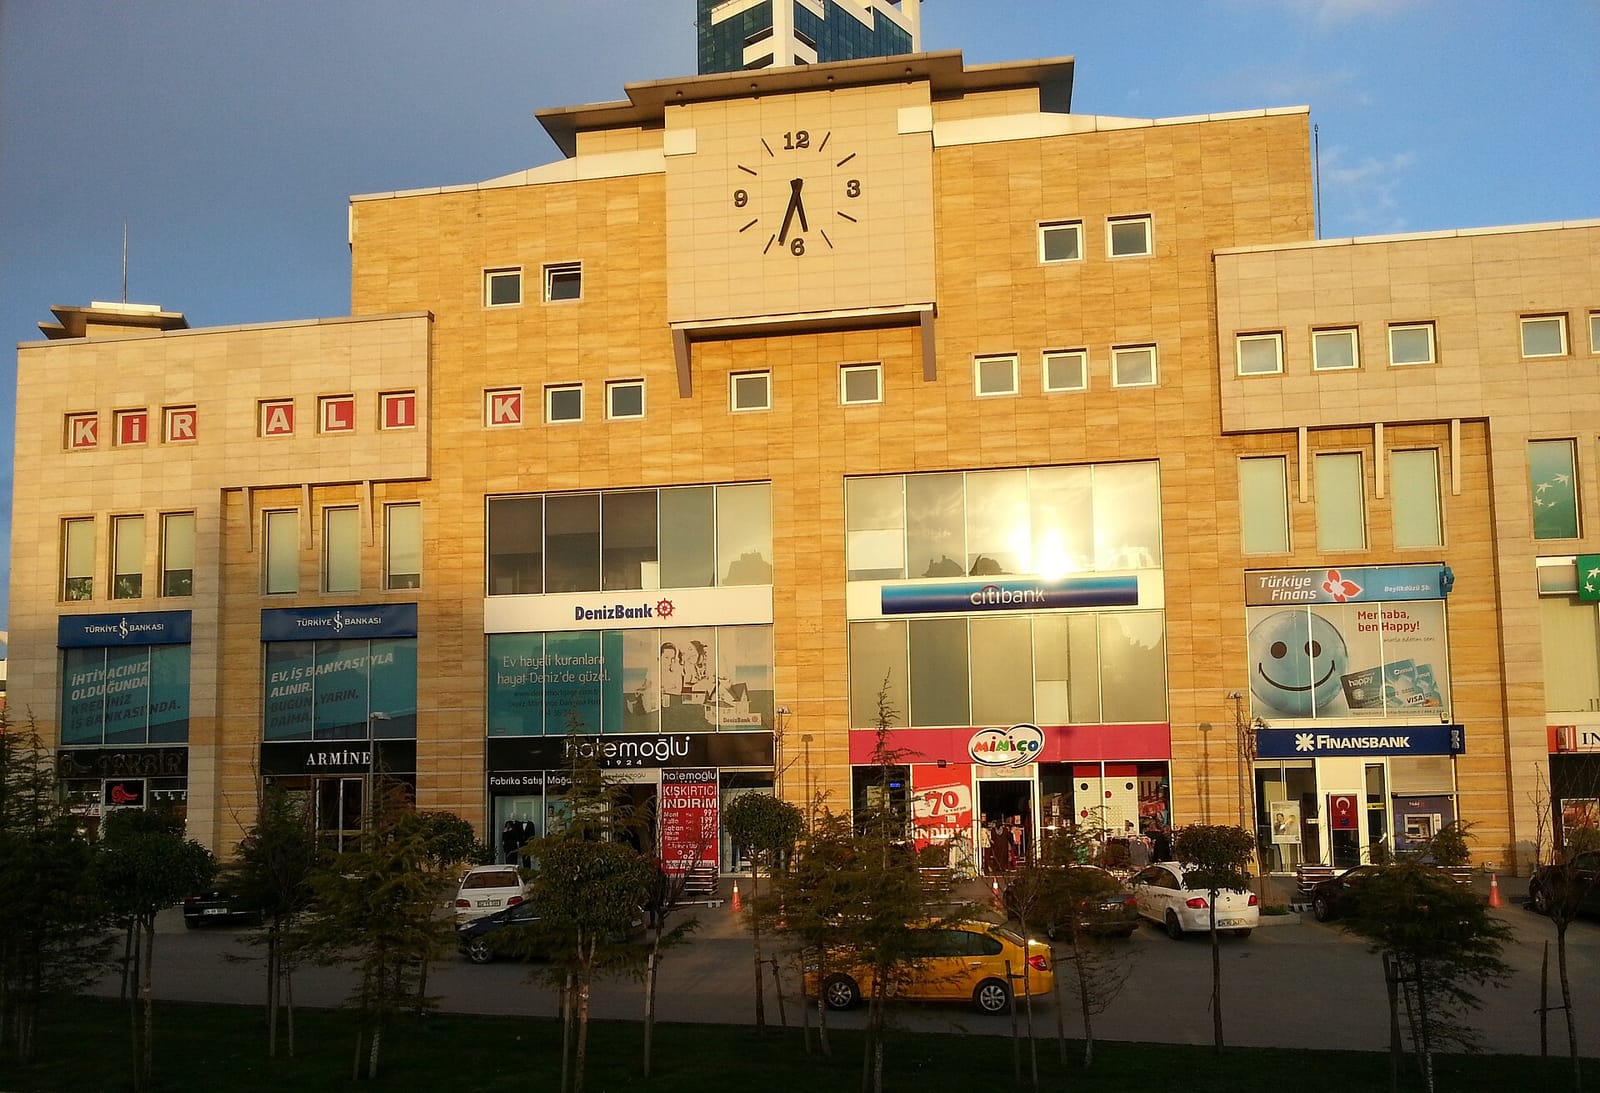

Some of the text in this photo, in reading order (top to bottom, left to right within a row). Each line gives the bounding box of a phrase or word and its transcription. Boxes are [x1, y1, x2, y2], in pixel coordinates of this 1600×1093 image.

[783, 130, 810, 150] 12
[846, 179, 861, 198] 3
[733, 189, 749, 208] 9
[790, 238, 805, 256] 6
[1260, 575, 1312, 590] Türkiye
[969, 586, 1047, 607] citibank
[1271, 587, 1317, 602] Finans
[574, 604, 653, 621] DenizBank
[84, 624, 118, 634] TÜRKİYE
[129, 623, 164, 633] BANKASI
[296, 618, 332, 627] TÜRKİYE
[344, 617, 382, 625] BANKASI
[1357, 620, 1420, 632] ben Happy!
[503, 653, 605, 670] Ev hayali kuranlara
[71, 661, 149, 687] İHTİYACINIZ
[497, 672, 527, 688] hayat
[270, 682, 313, 698] ALINIR.
[1406, 695, 1424, 704] VISA
[306, 749, 371, 766] ARMİNE
[925, 790, 960, 815] 70
